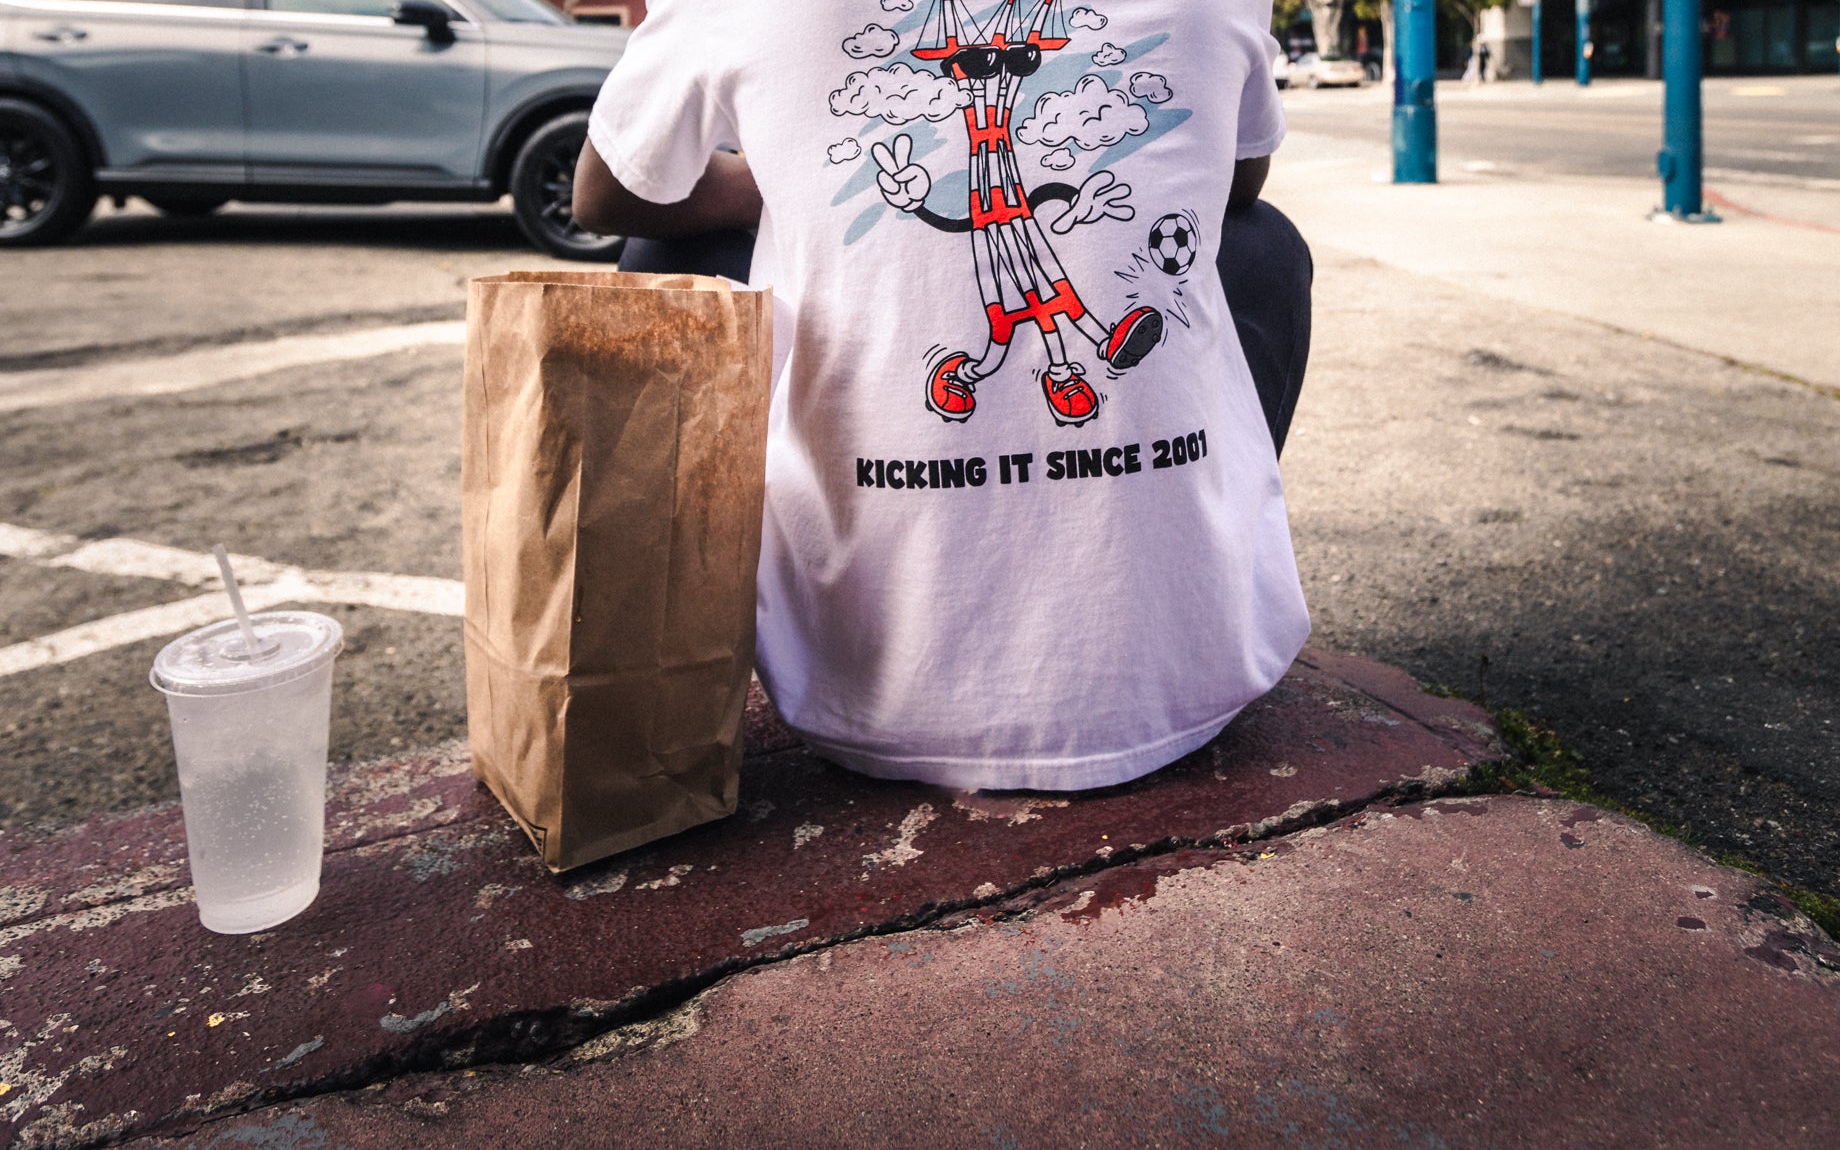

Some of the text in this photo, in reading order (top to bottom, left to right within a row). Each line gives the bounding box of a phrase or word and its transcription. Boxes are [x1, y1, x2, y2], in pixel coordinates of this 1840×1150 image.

[857, 428, 1208, 489] KICKING IT SINCE 2001
